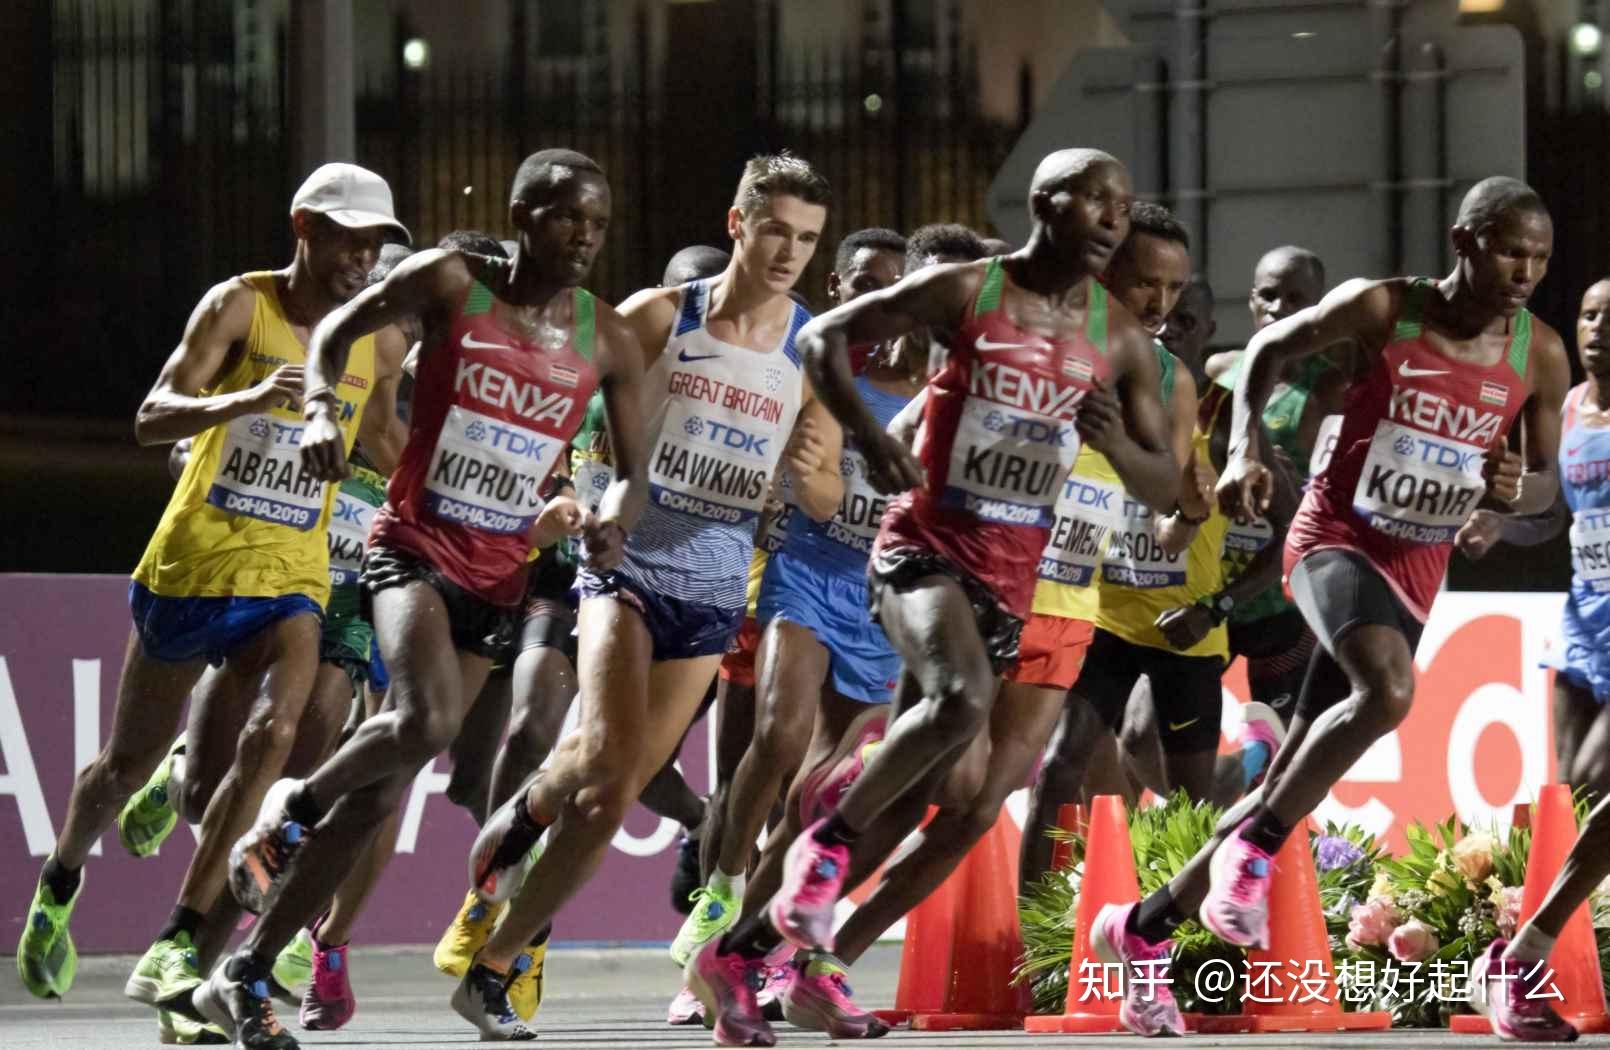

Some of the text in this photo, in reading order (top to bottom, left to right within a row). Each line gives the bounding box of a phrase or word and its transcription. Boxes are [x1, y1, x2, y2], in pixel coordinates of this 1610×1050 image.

[454, 357, 573, 428] KENYA
[668, 371, 784, 424] GREAT BRITAIN
[1009, 416, 1073, 447] TDK
[1389, 384, 1504, 444] KENYA
[490, 425, 548, 462] TDK
[706, 420, 769, 457] TDK
[655, 442, 767, 500] HAWKINS
[964, 445, 1060, 496] KIRUI
[1418, 441, 1474, 472] TDK
[659, 490, 742, 524] DOHA2019
[1063, 479, 1114, 511] TDK
[1366, 464, 1475, 516] KORIR
[225, 494, 309, 525] DOHA2019
[332, 498, 366, 527] DK
[437, 499, 523, 532] DOHA2019
[1371, 515, 1449, 544] DOHA2019
